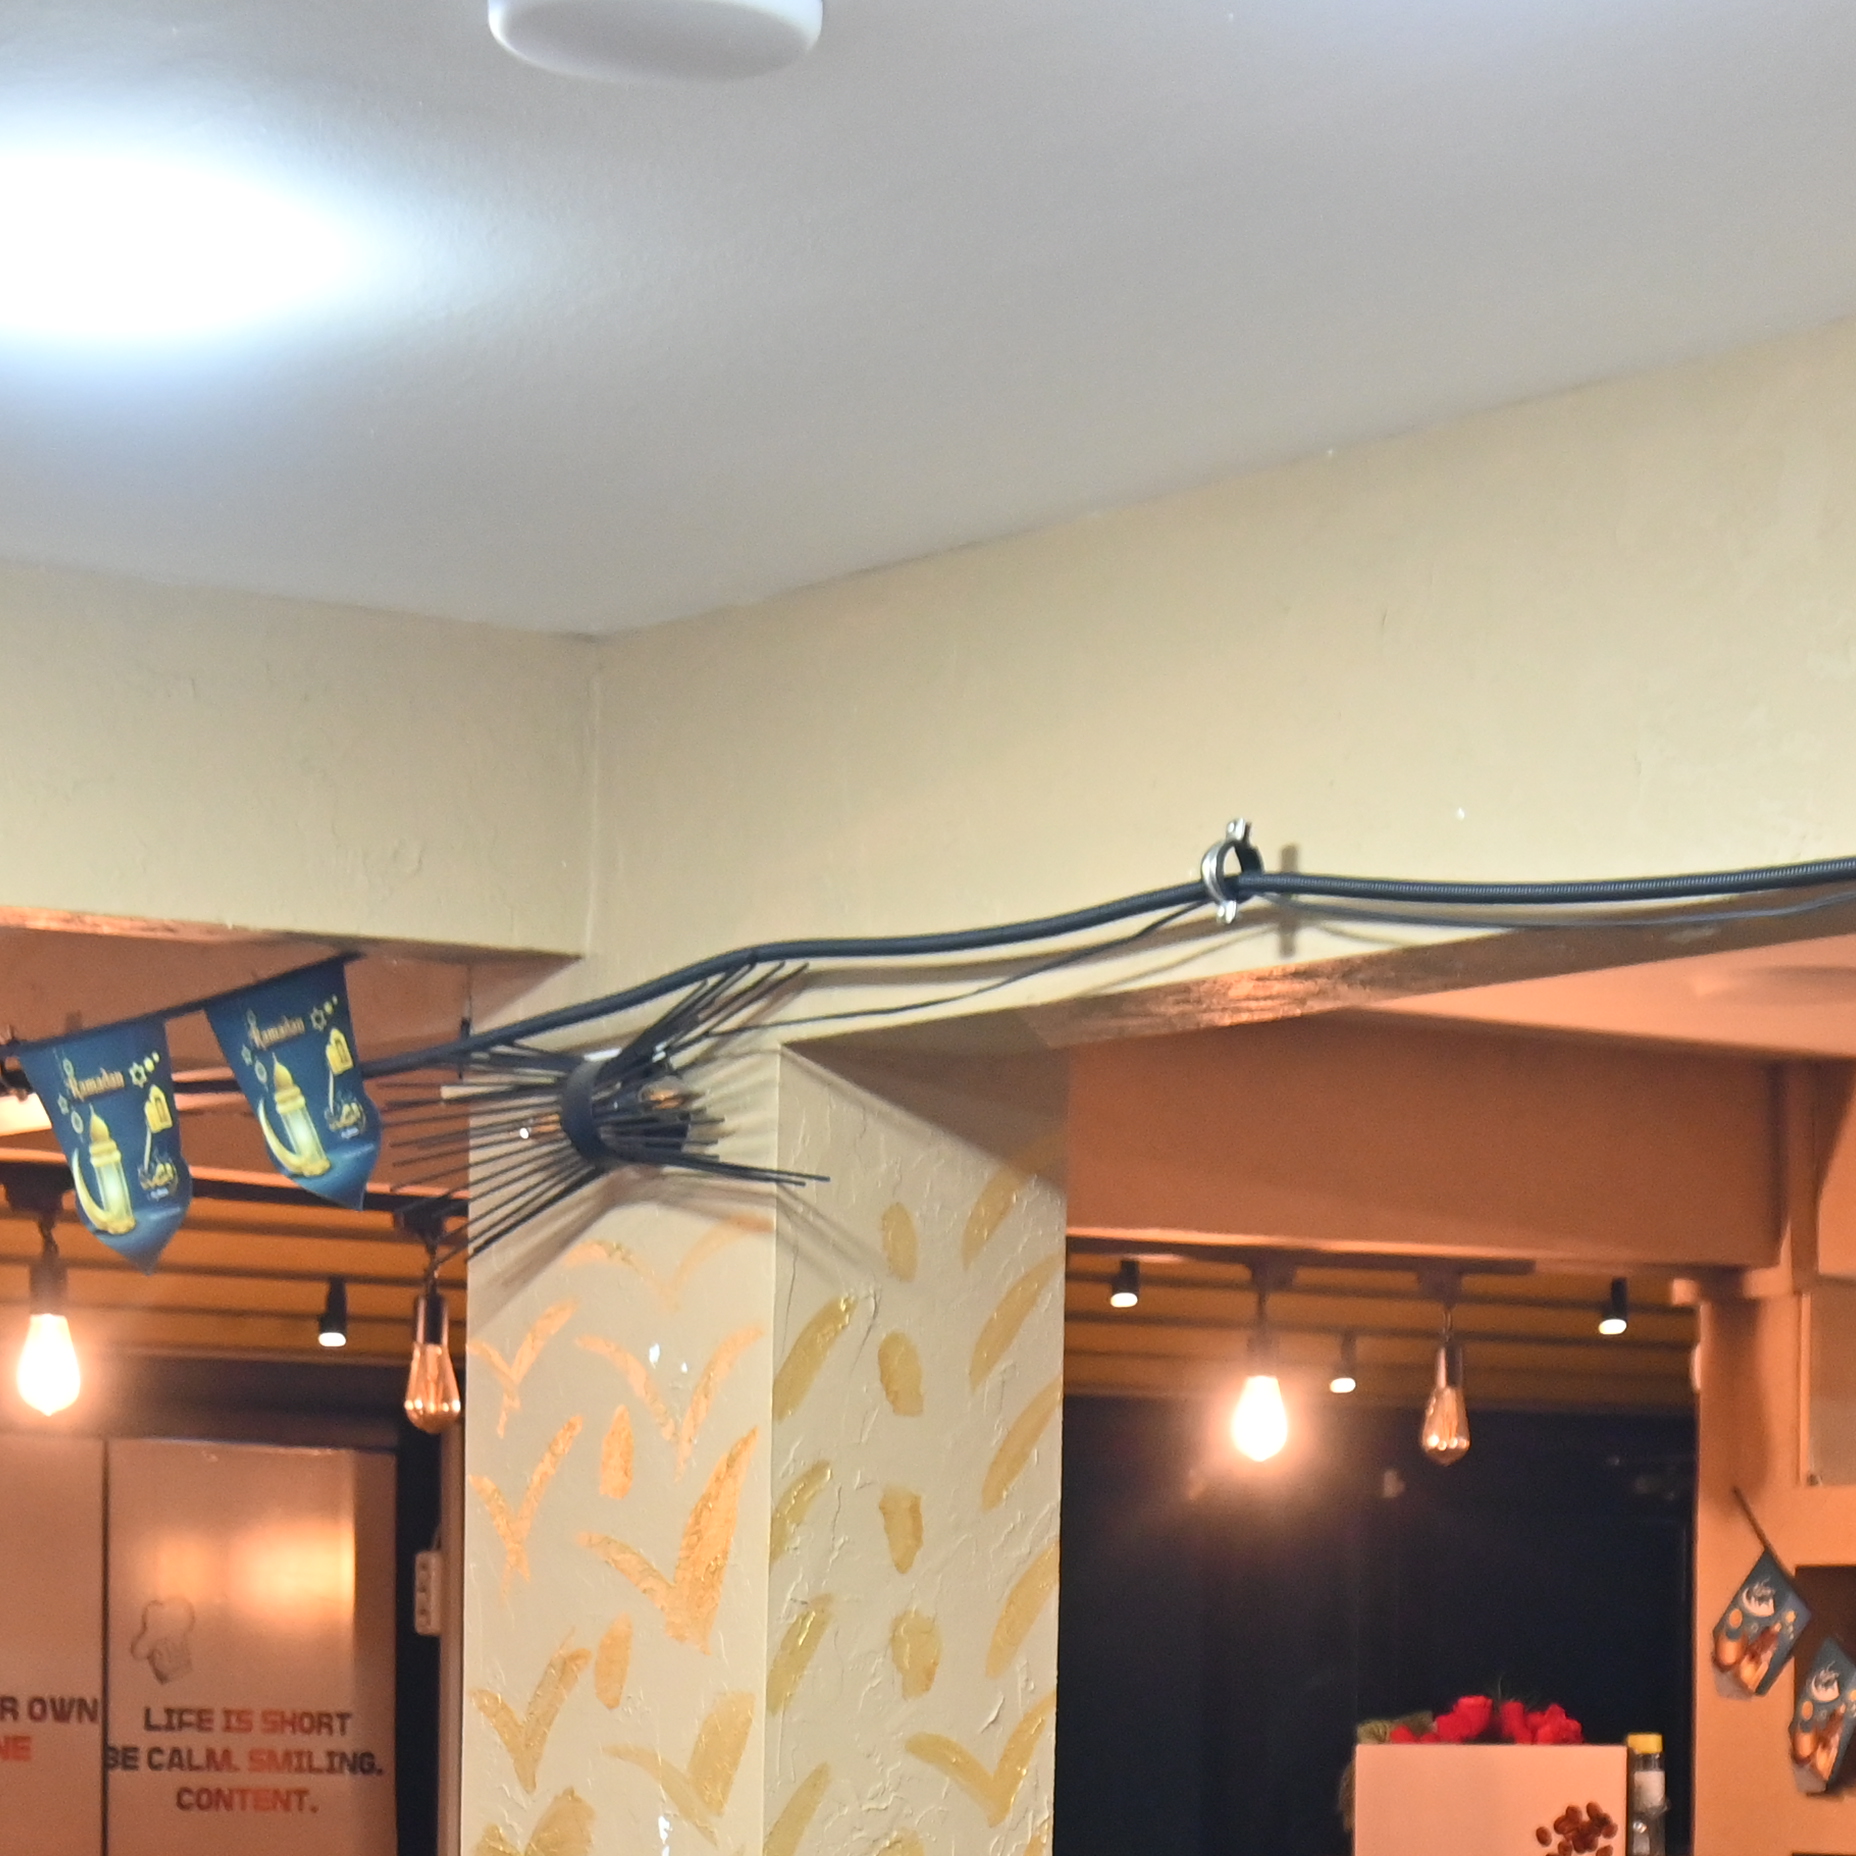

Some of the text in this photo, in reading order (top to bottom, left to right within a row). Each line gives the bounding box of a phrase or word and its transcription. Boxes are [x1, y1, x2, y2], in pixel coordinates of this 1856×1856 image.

[26, 1694, 100, 1724] OWN
[144, 1707, 352, 1736] LIFE IS SHORT
[104, 1746, 384, 1776] BE CALM. SMILING.
[175, 1786, 320, 1815] CONTENT.
